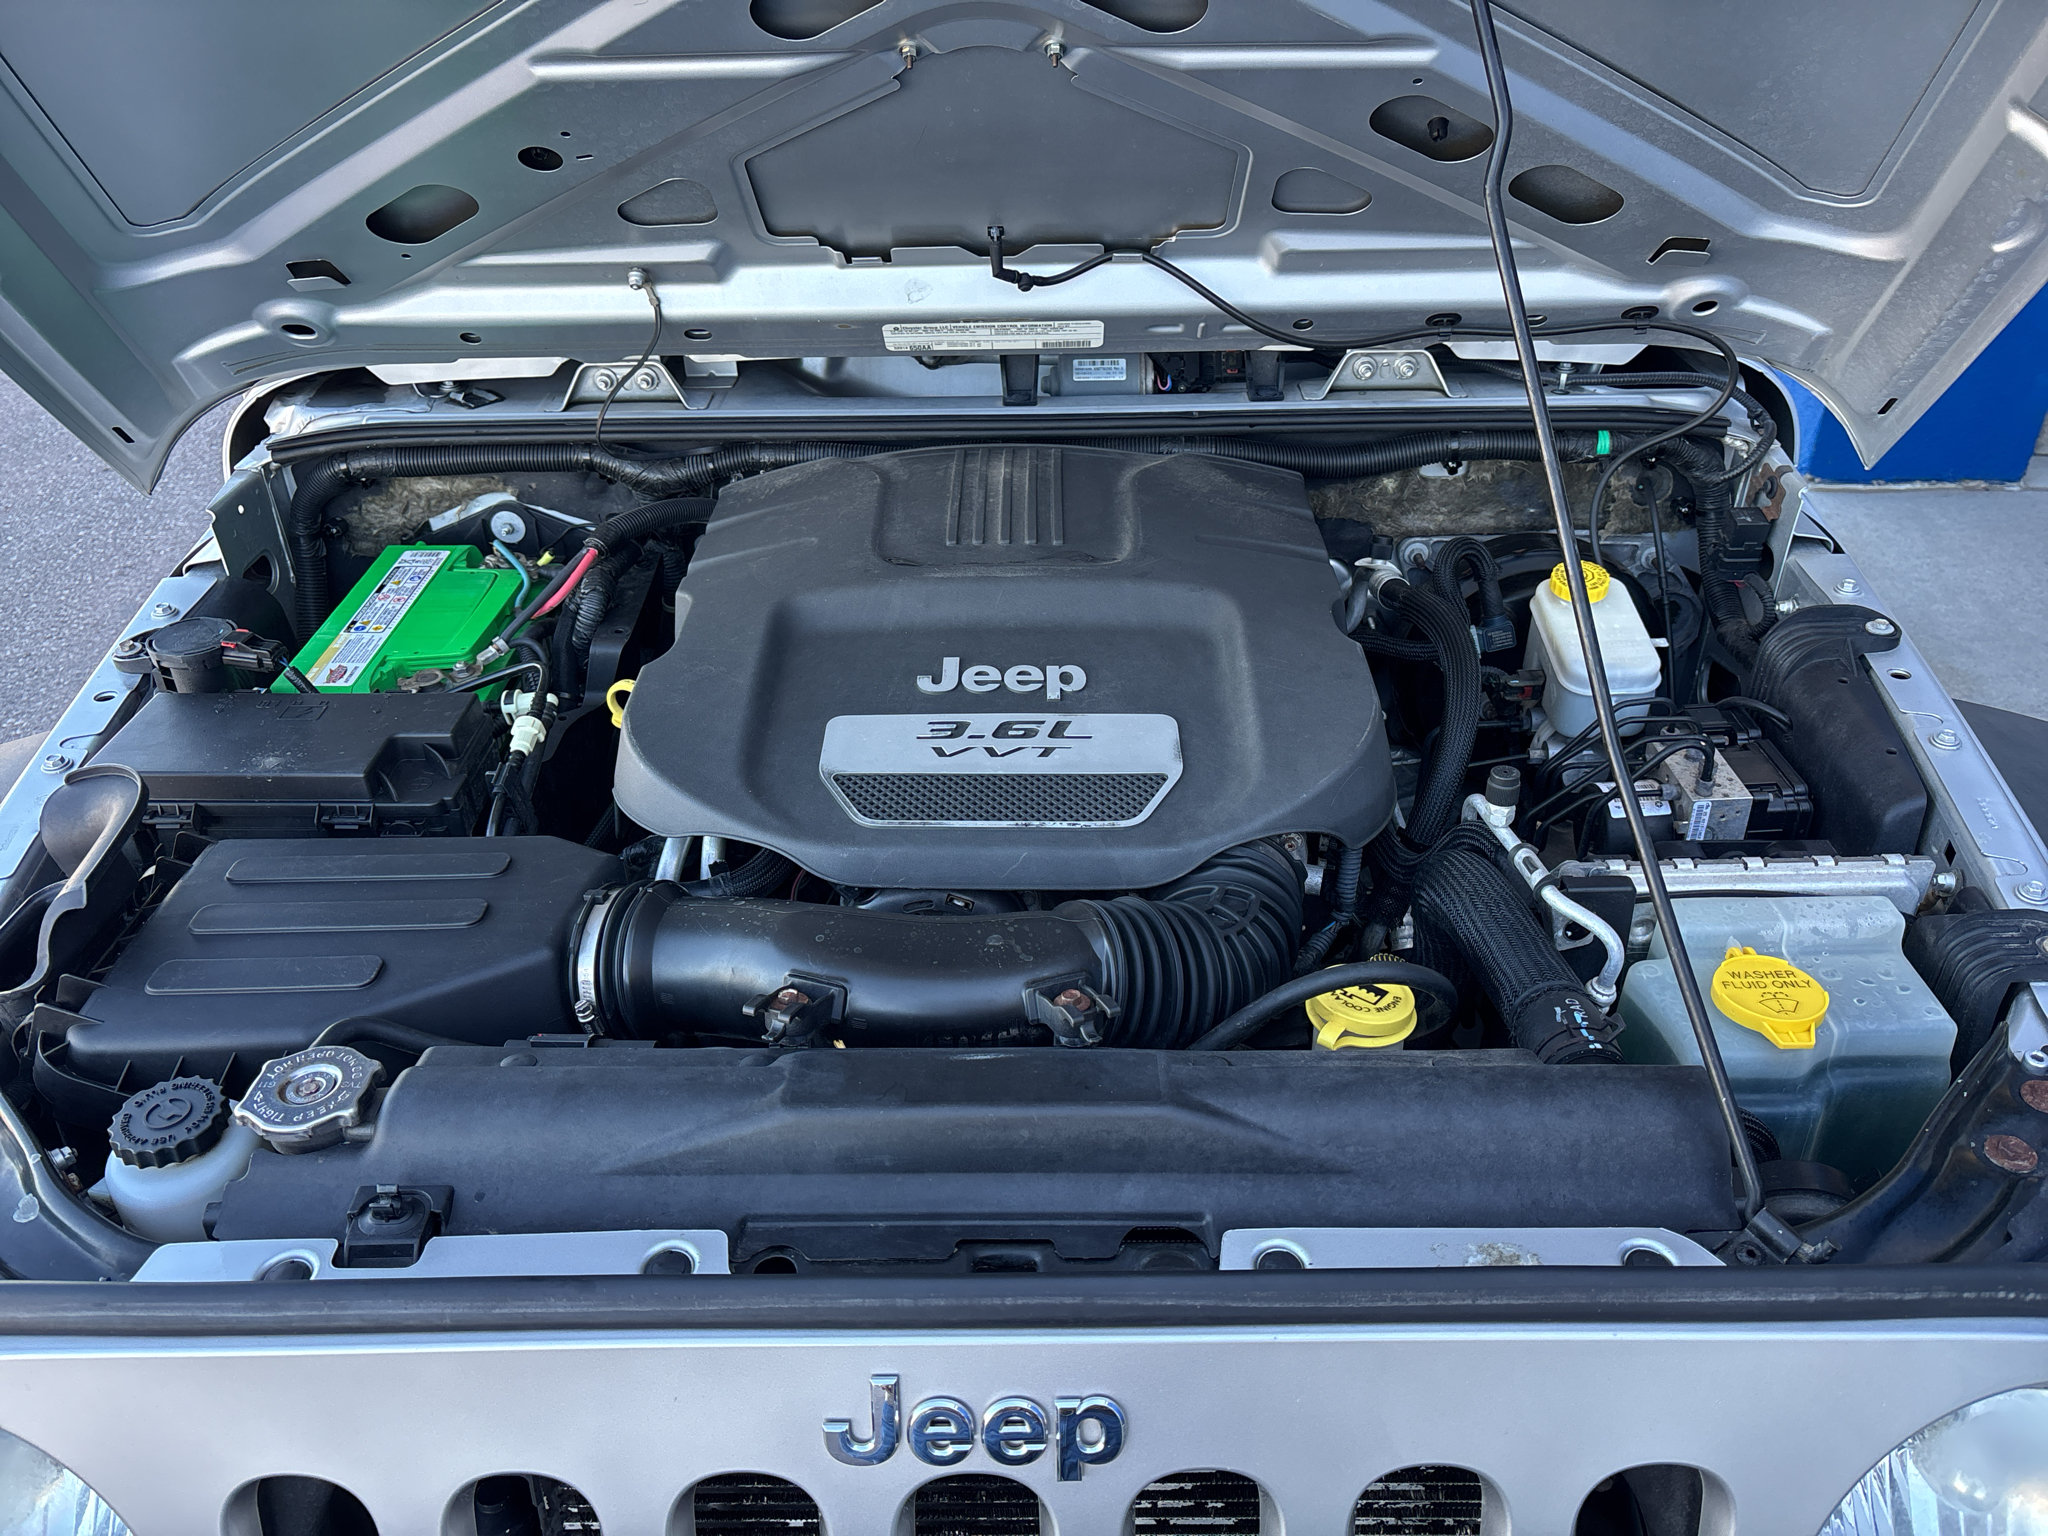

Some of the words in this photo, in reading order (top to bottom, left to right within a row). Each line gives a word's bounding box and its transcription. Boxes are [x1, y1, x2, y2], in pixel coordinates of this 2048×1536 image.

[916, 656, 1087, 701] Jeep
[916, 720, 1093, 739] 3.6L
[931, 746, 1072, 758] VVT
[1726, 970, 1798, 980] WASHER
[1721, 980, 1768, 990] FLUID
[1772, 979, 1812, 989] ONLY
[1375, 996, 1402, 1014] ENGINE
[295, 1050, 335, 1063] OPEN
[336, 1052, 358, 1068] NOT
[352, 1066, 363, 1080] DO
[253, 1102, 286, 1122] TIGHT
[292, 1100, 337, 1122] KEEP
[822, 1373, 1127, 1482] Jeep
